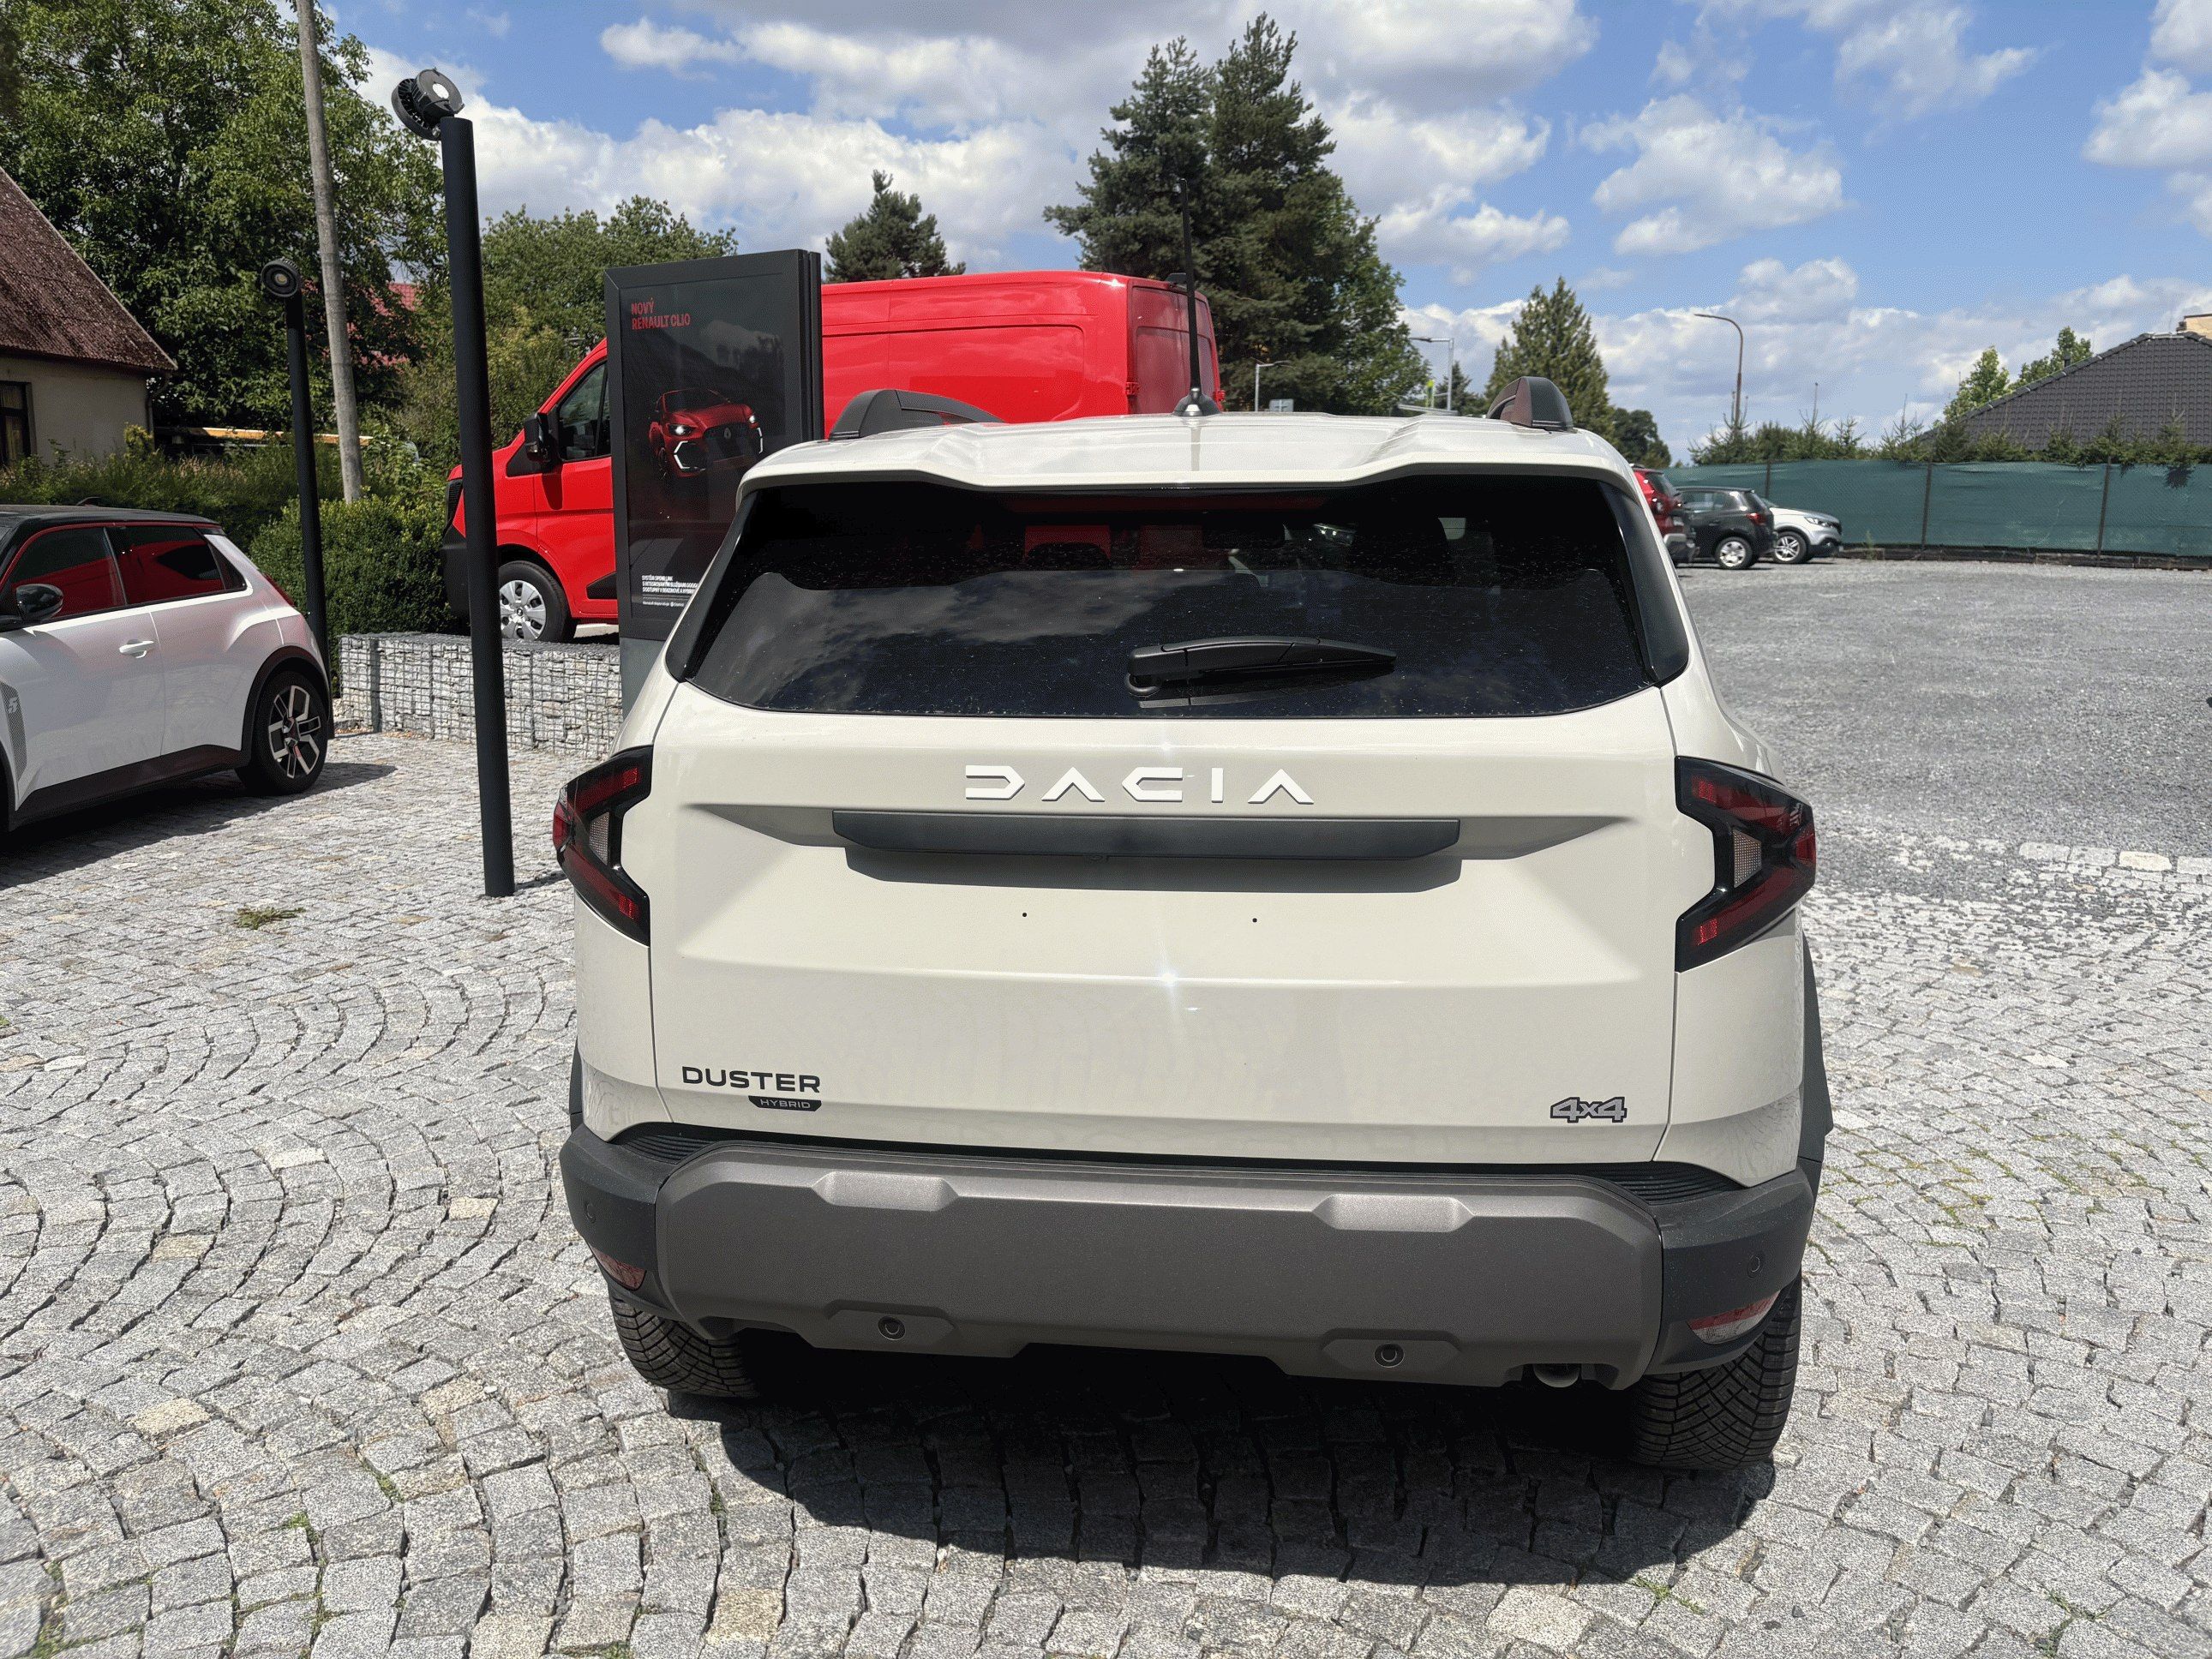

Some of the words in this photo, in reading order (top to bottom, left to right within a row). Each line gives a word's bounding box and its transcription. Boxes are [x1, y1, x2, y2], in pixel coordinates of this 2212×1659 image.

[631, 297, 655, 315] NOVÝ
[632, 314, 670, 330] RENAULT
[671, 313, 691, 327] CLIO
[965, 764, 1315, 805] DACIA
[681, 1066, 821, 1093] DUSTER
[759, 1098, 812, 1110] HYBRID
[1550, 1096, 1628, 1123] 4x4
